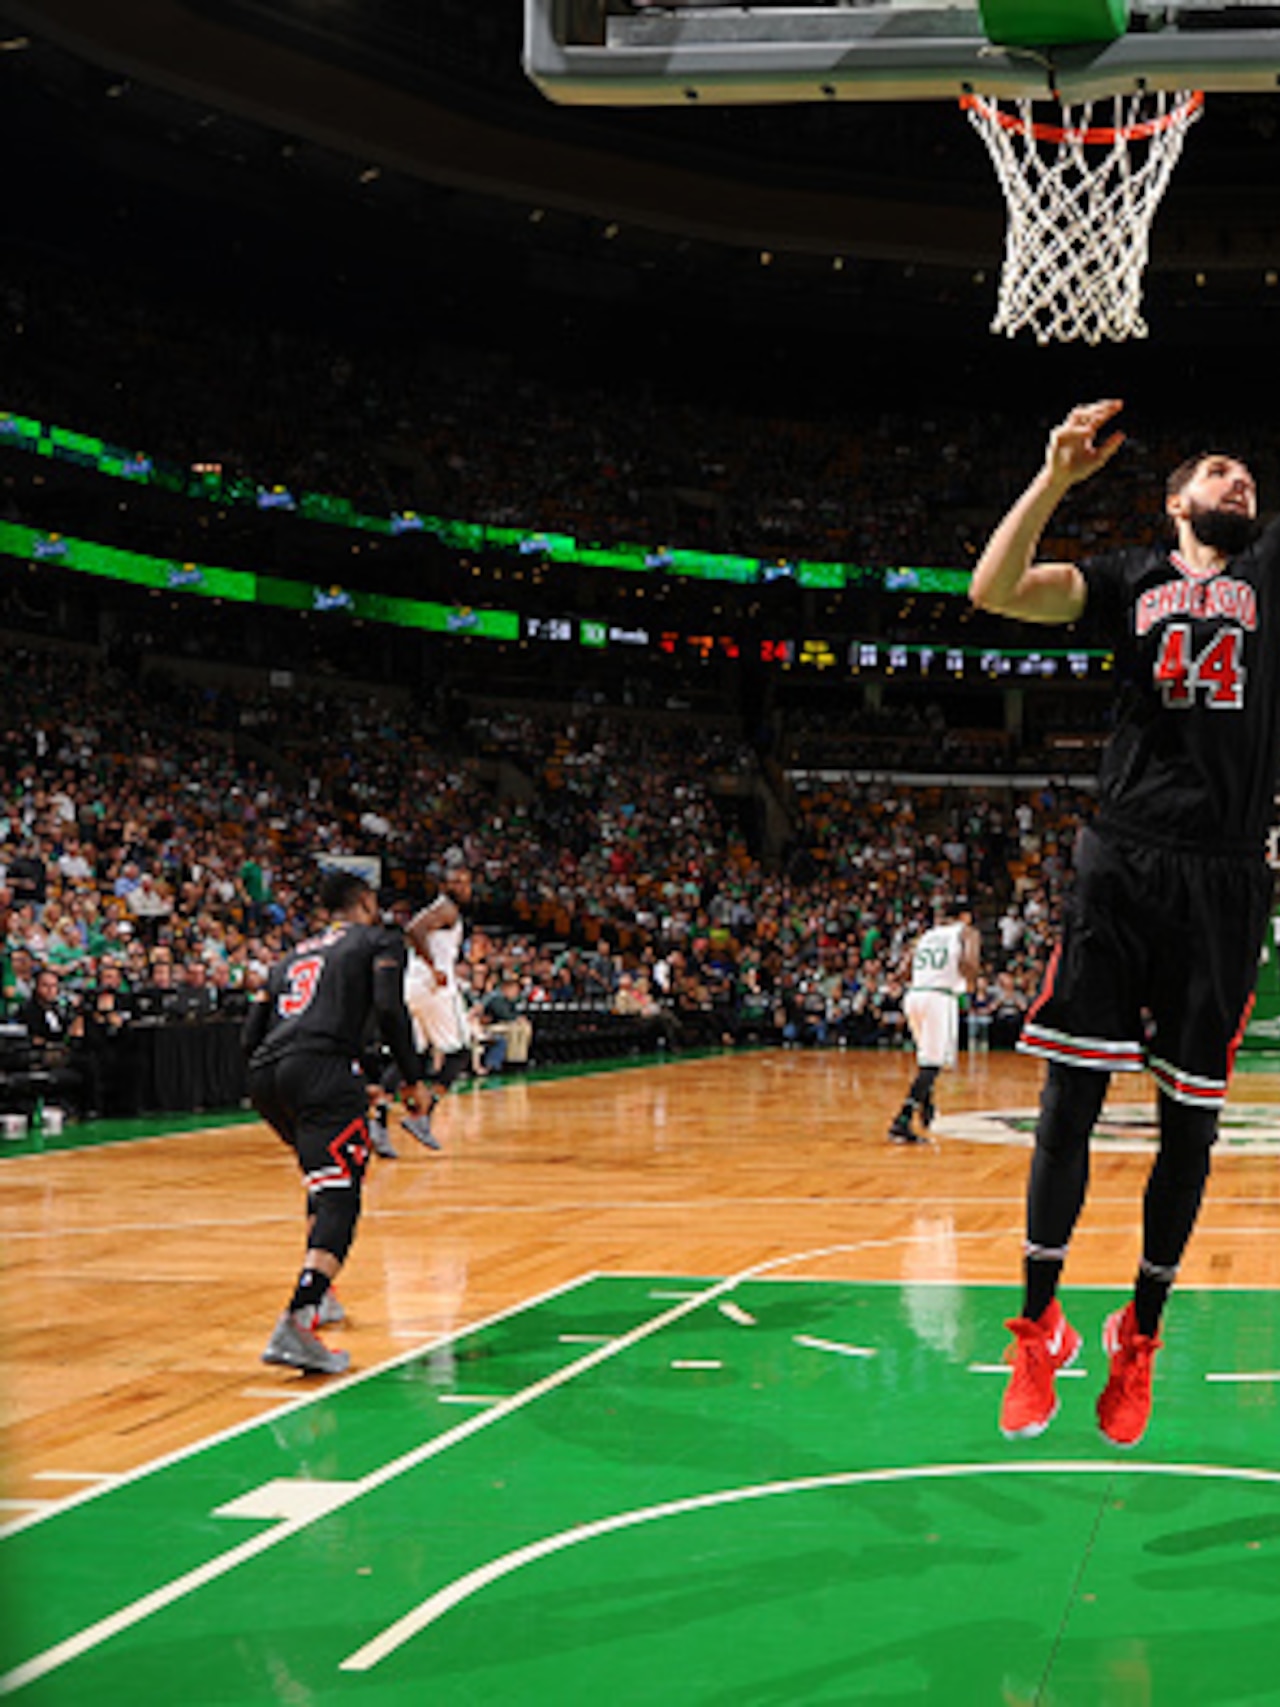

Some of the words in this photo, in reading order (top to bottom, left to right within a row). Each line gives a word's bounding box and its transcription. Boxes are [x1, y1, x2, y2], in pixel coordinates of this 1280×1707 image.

[1135, 577, 1257, 637] CHICAGO
[1152, 622, 1246, 710] 44
[277, 954, 326, 1019] 3
